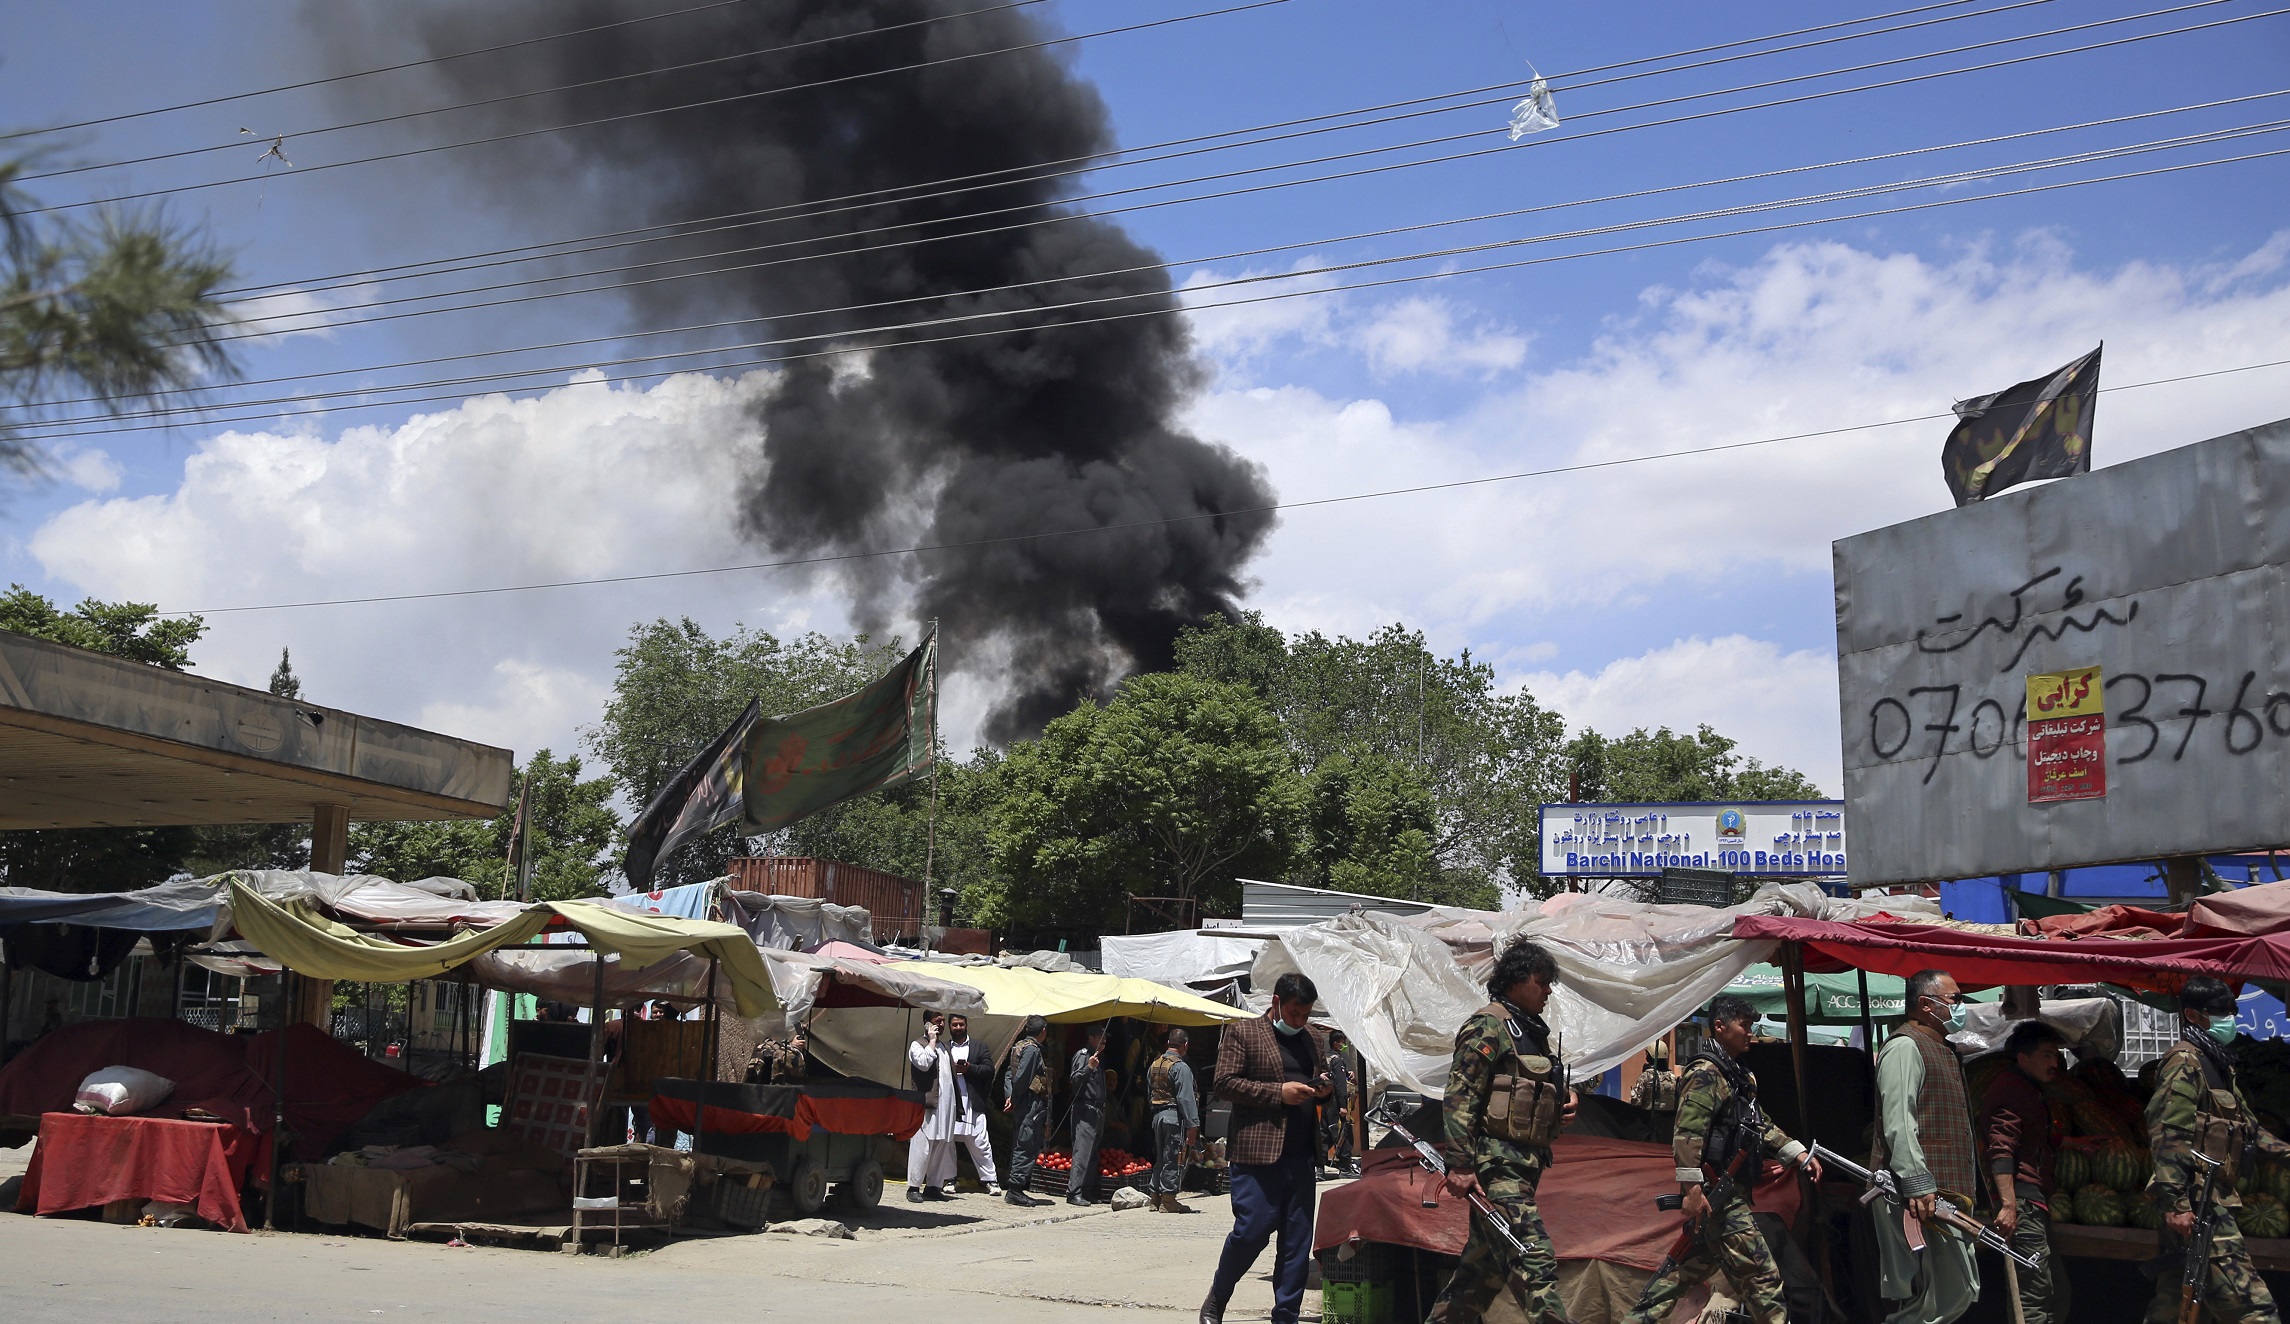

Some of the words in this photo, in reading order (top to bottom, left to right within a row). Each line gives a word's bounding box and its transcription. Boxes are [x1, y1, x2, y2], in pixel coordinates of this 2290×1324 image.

[2070, 719, 2101, 736] شرکت
[1574, 812, 1602, 825] وزارت
[1792, 809, 1812, 820] عامه
[1815, 809, 1841, 820] صحت
[1622, 831, 1635, 843] سل
[1804, 828, 1823, 844] بستر
[1826, 831, 1841, 840] صد
[1566, 851, 1627, 867] Barchi
[1754, 850, 1805, 867] Beds
[1807, 850, 1846, 867] Hos
